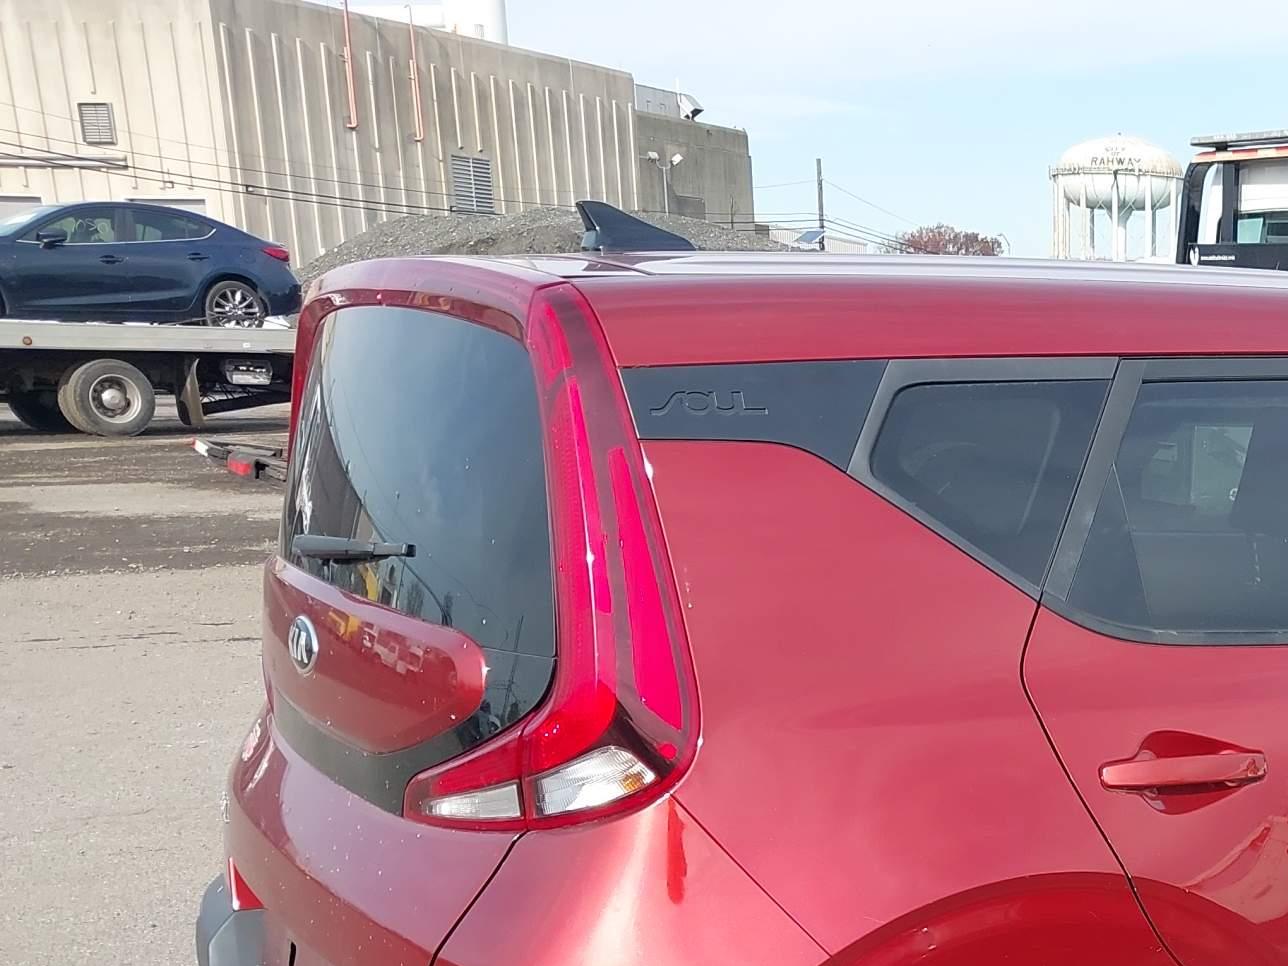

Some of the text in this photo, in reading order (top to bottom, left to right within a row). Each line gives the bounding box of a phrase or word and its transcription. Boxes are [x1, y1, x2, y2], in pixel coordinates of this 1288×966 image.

[1090, 157, 1141, 167] RAHWAY
[648, 390, 769, 416] SOUL
[288, 620, 309, 664] KIA
